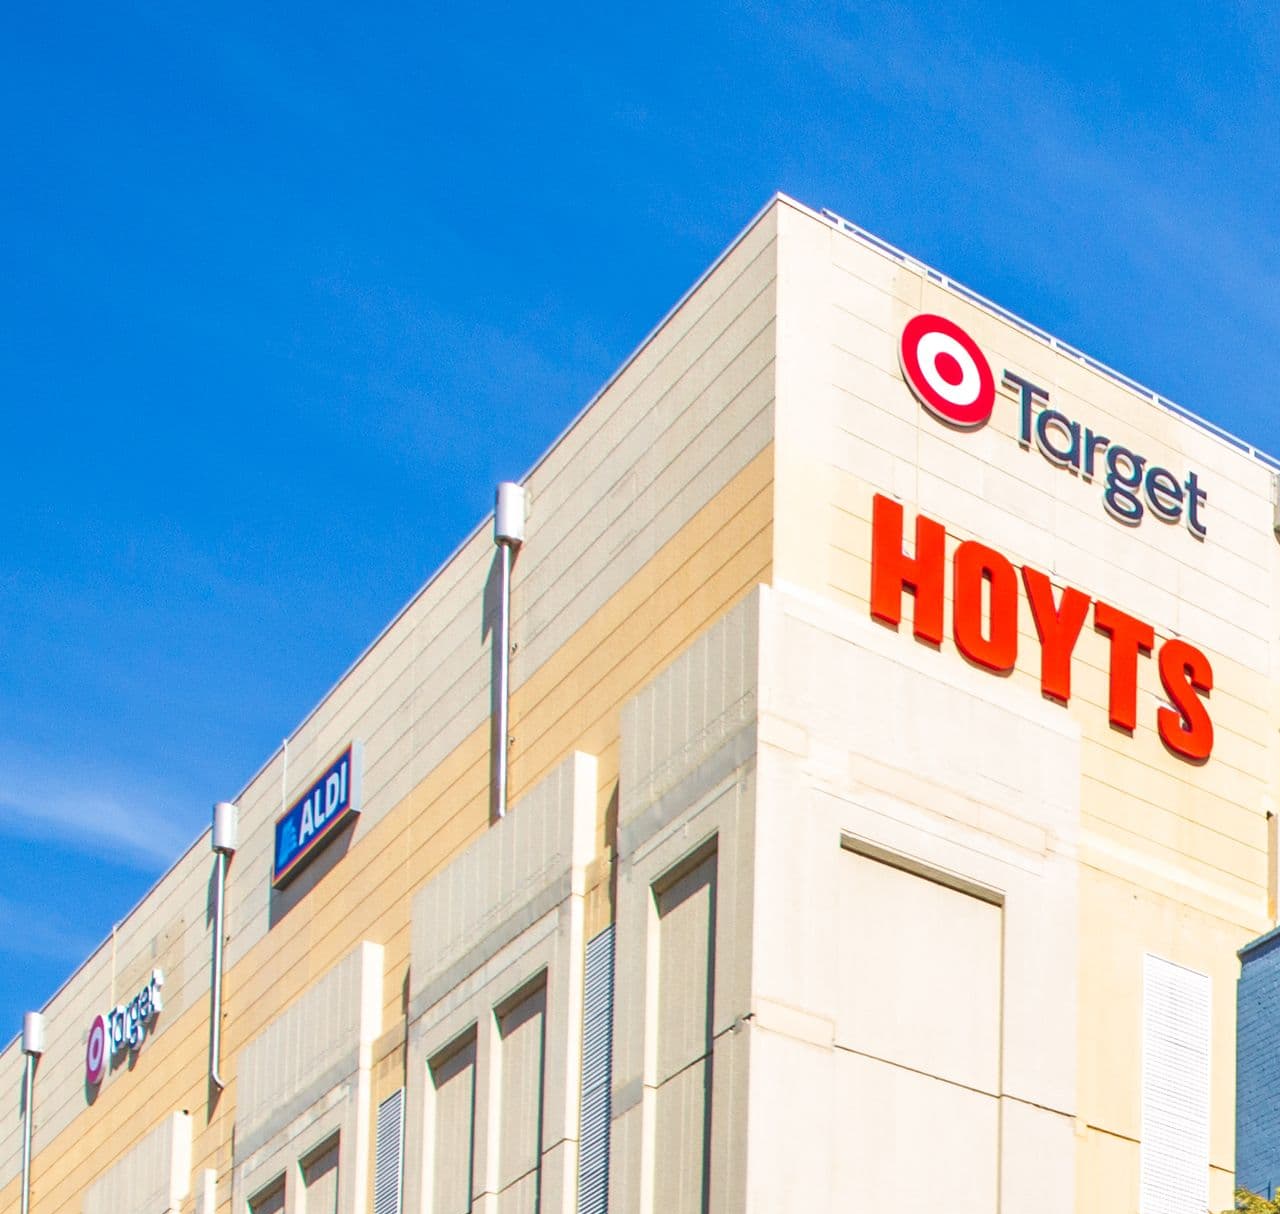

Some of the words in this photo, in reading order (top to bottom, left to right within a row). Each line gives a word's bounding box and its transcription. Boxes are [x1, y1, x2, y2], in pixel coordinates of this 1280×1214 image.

[1001, 368, 1208, 541] Target
[870, 492, 1214, 767] HOYTS
[298, 761, 347, 846] ALDI
[108, 968, 163, 1054] Target
